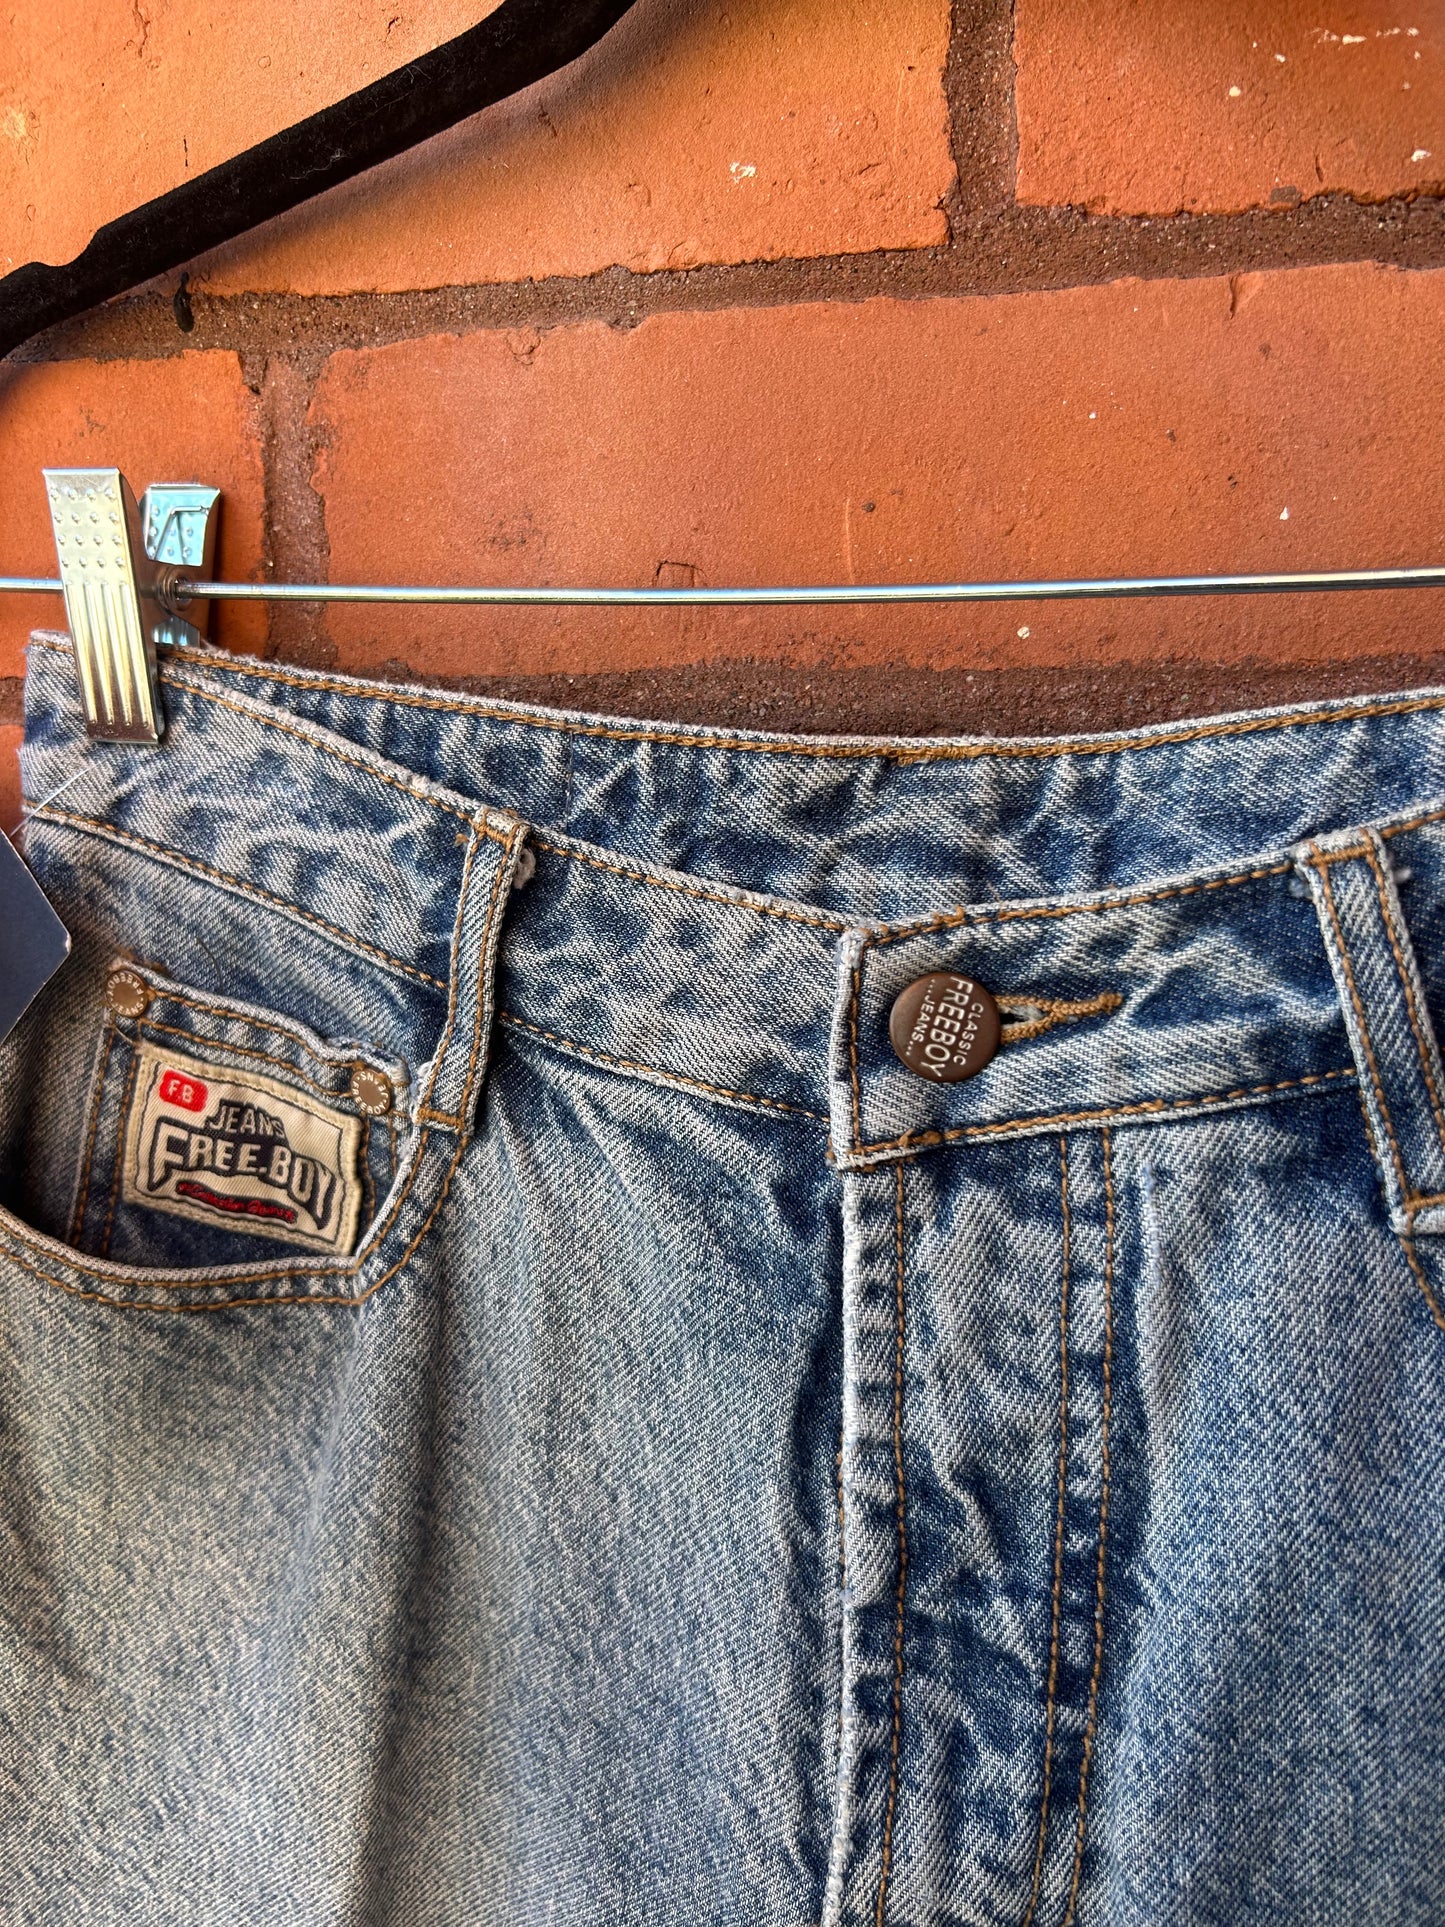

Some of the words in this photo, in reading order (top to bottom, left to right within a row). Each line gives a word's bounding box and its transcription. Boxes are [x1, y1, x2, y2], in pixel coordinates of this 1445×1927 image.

[920, 976, 974, 1077] FREEBOY
[953, 1002, 984, 1066] CLASSIC
[208, 1105, 286, 1140] JEANS
